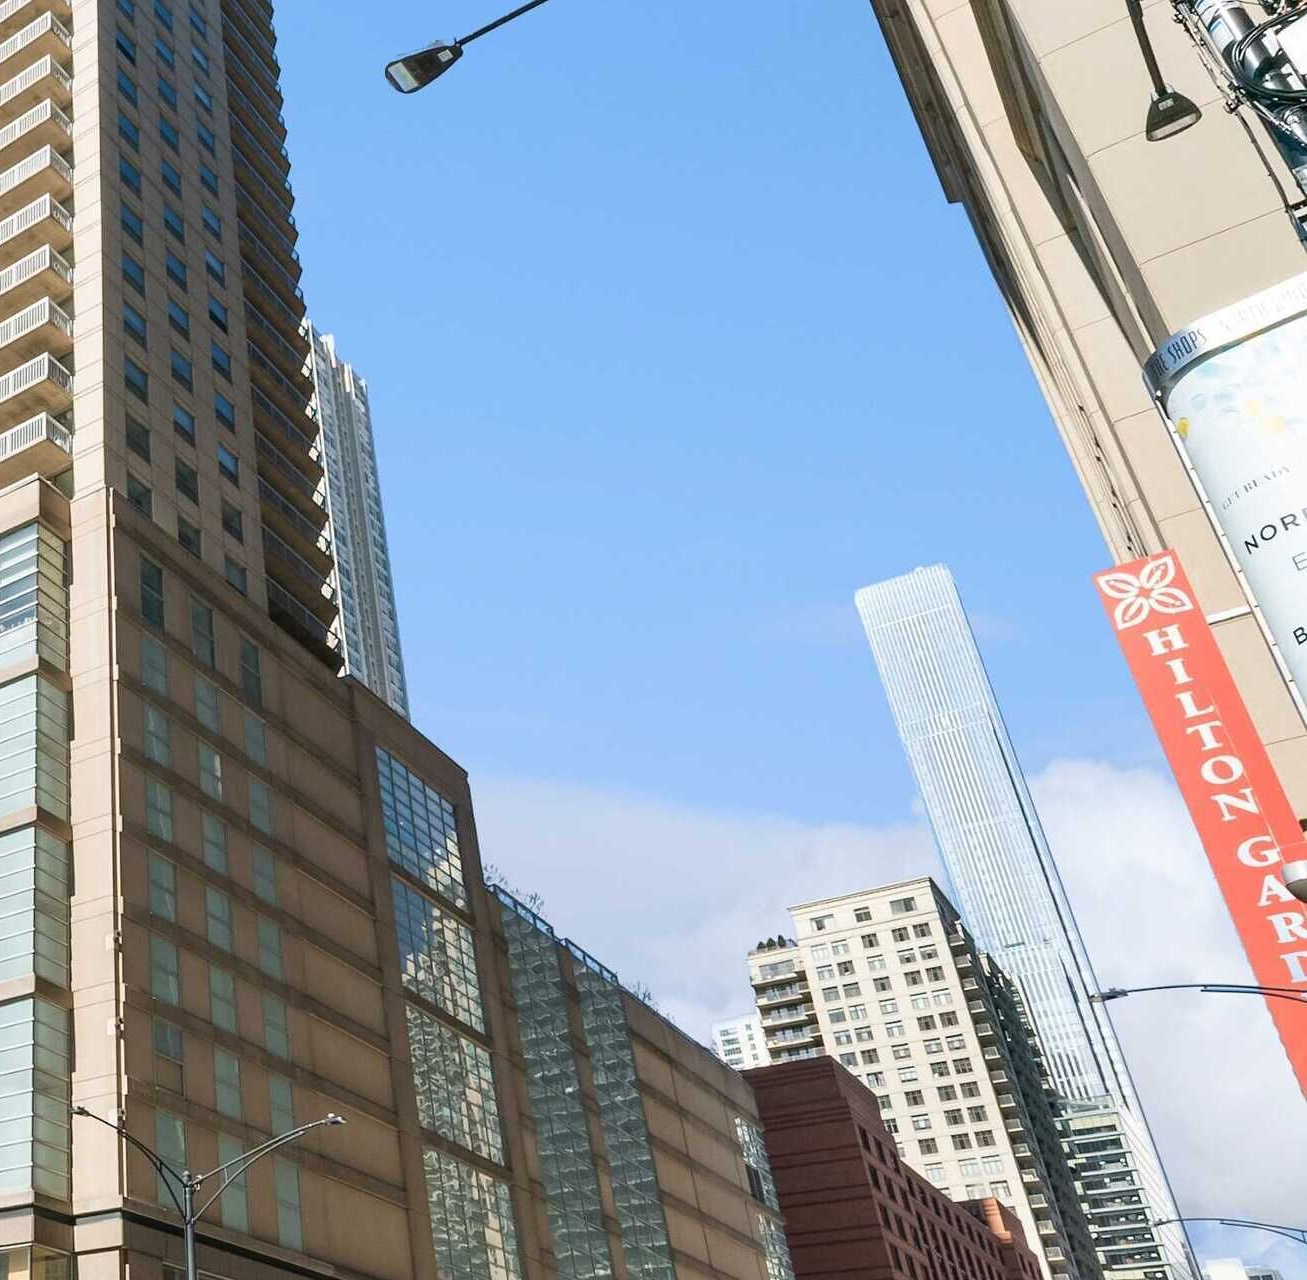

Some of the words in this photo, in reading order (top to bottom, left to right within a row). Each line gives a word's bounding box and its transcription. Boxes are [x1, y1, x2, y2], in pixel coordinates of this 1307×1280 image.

[1168, 328, 1208, 365] SHOPS
[1244, 506, 1307, 555] NOR
[1143, 624, 1261, 822] HILTON
